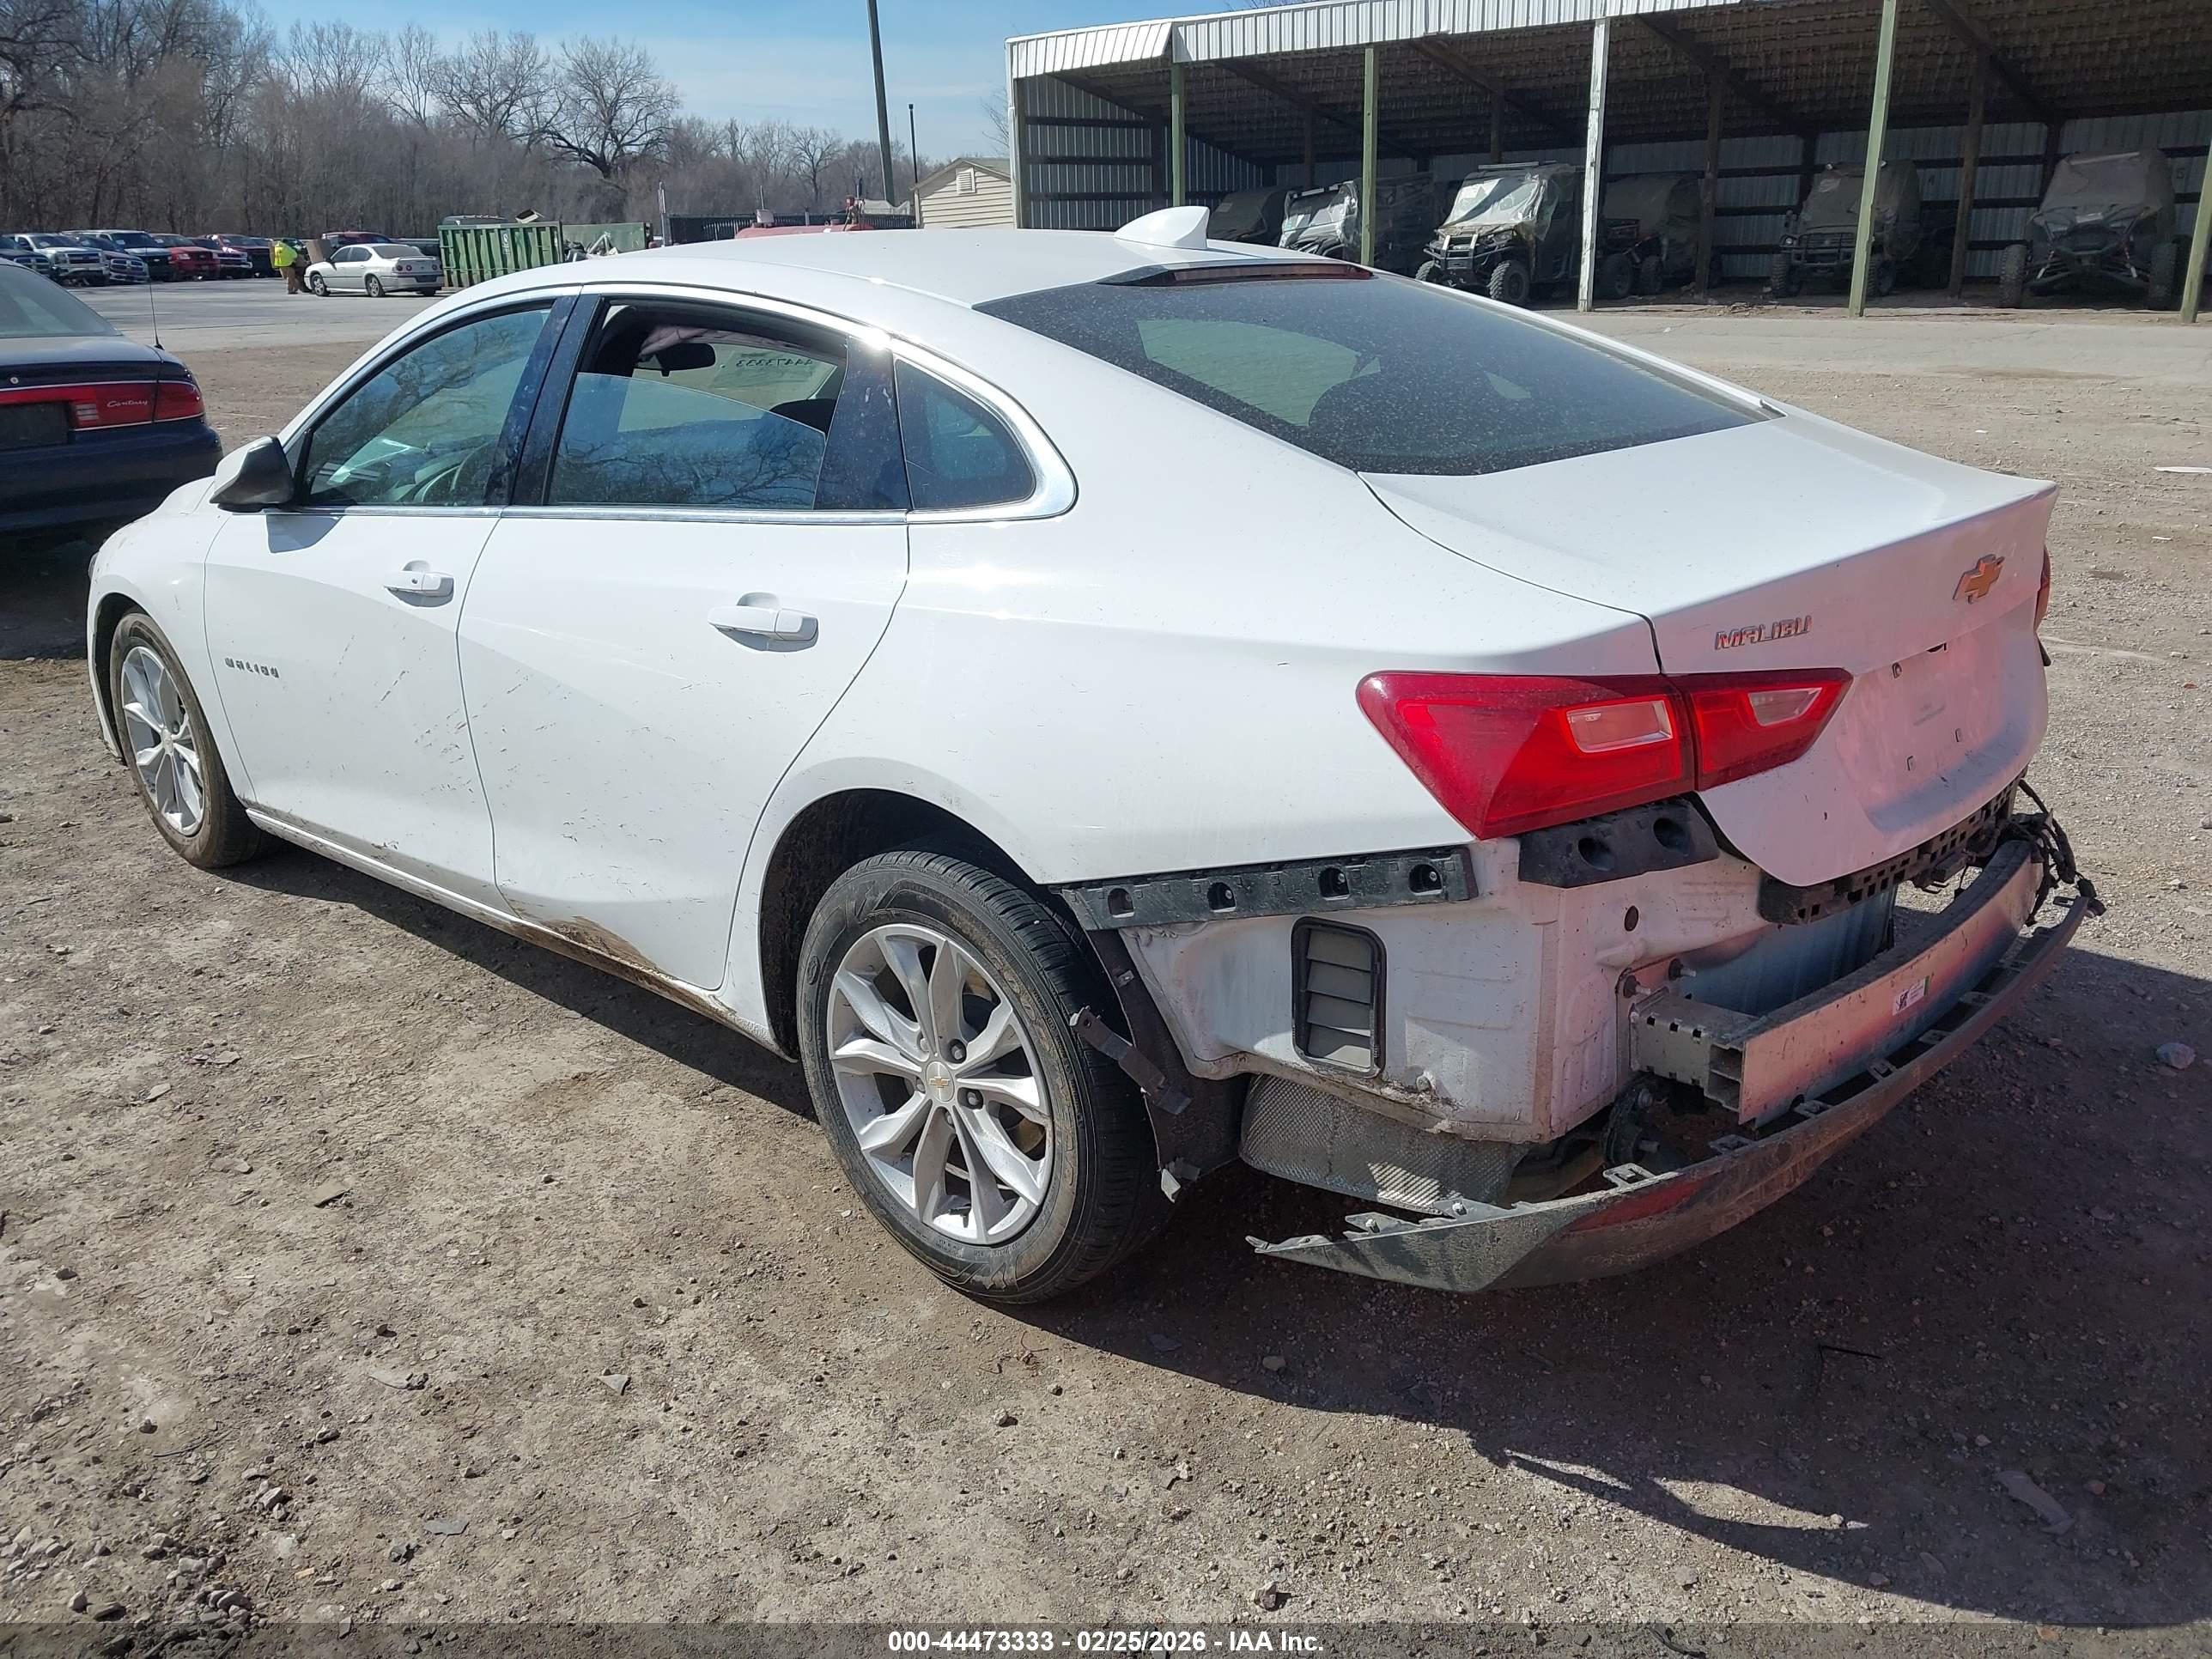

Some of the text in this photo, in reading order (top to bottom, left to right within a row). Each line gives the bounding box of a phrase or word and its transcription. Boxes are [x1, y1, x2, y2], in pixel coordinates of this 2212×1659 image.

[106, 398, 149, 408] Century
[1715, 615, 1814, 650] MALIBU
[224, 657, 280, 678] MALIBU
